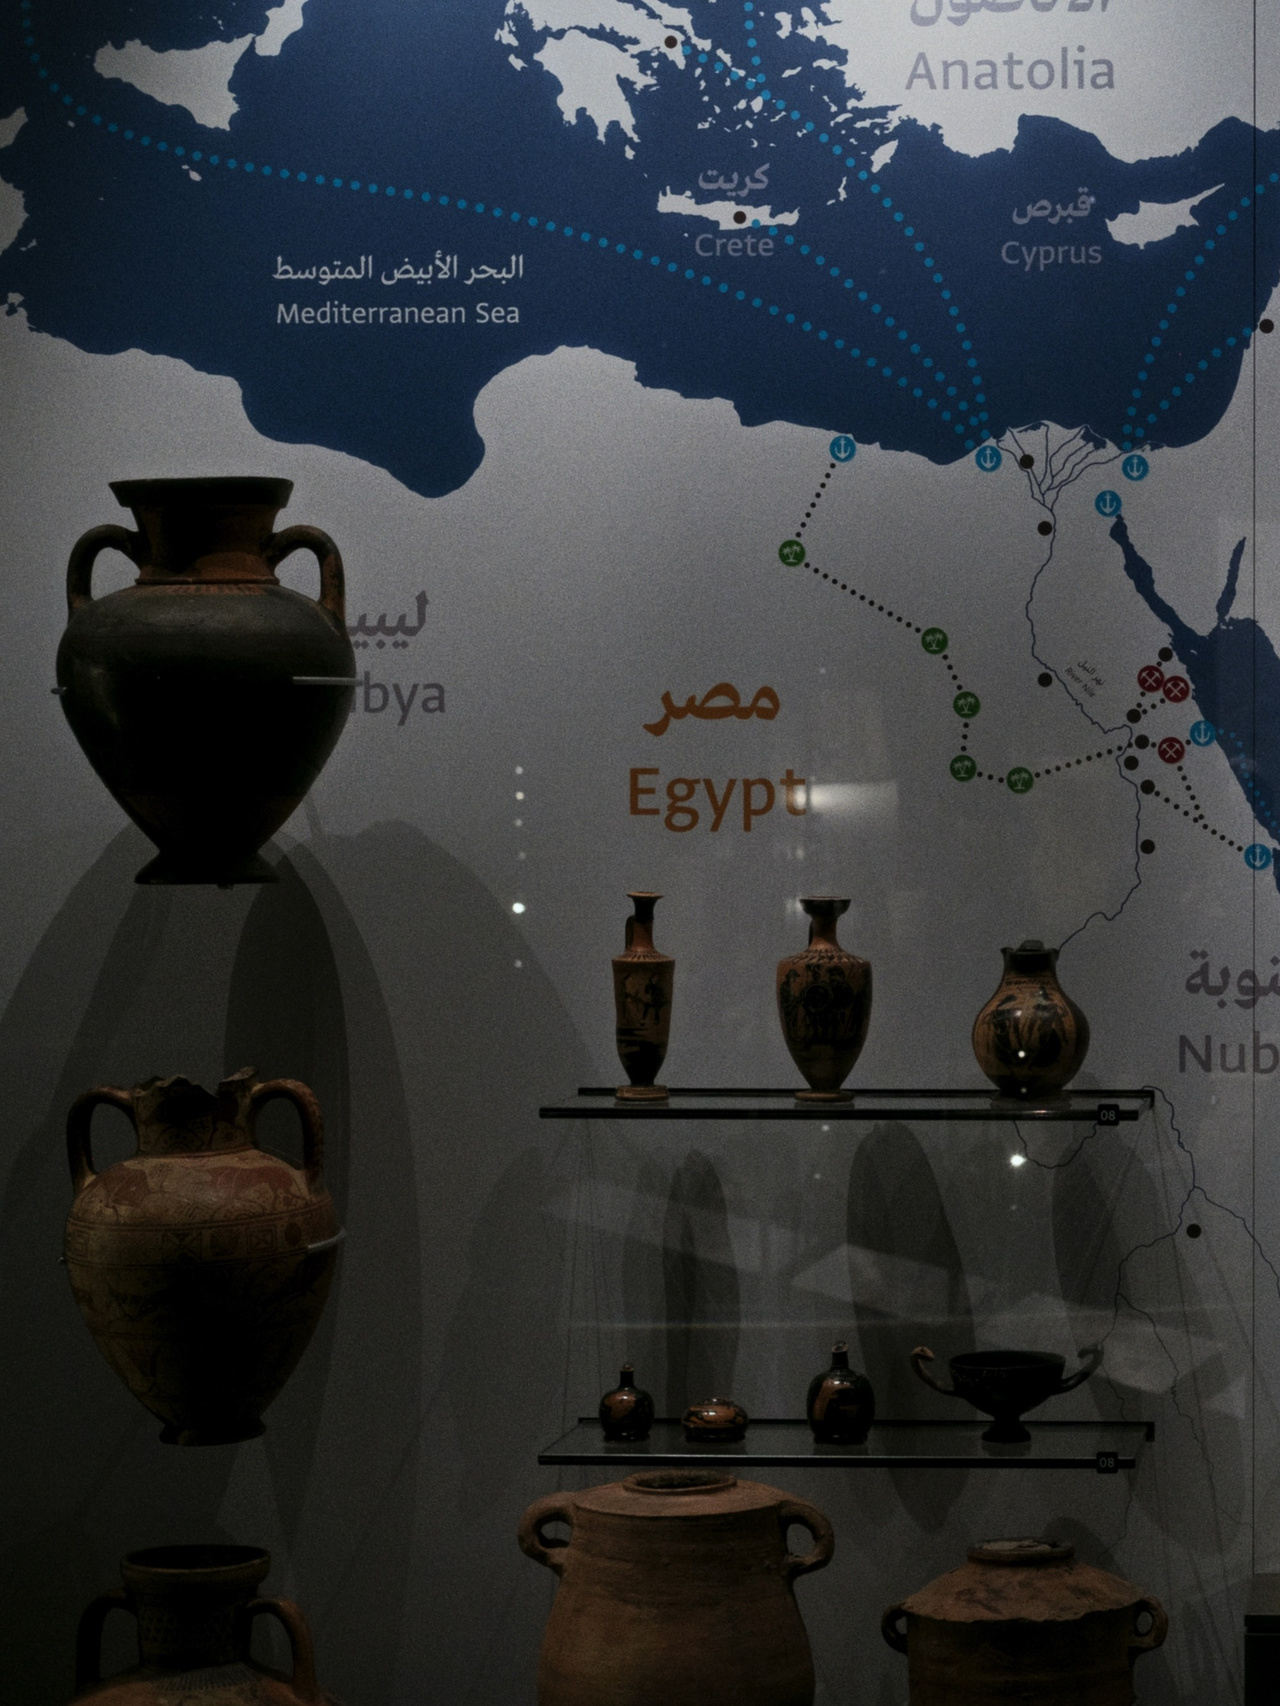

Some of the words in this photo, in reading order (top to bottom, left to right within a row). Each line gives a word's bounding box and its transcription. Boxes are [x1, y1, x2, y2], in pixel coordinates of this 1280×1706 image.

[906, 45, 1115, 90] Anatolia
[698, 163, 770, 194] كريت
[1012, 187, 1096, 225] قبرص
[695, 232, 774, 257] Crete
[1001, 241, 1102, 271] Cyprus
[273, 255, 372, 285] المتوسط
[381, 250, 457, 285] الأبيض
[465, 255, 523, 284] البحر
[277, 301, 465, 324] Mediterranean
[476, 303, 519, 323] Sea
[346, 590, 429, 649] ليبي
[351, 670, 445, 726] bya
[643, 683, 780, 737] مصر
[630, 768, 806, 832] Egypt
[1100, 1110, 1116, 1121] 08
[1099, 1456, 1115, 1468] 08
